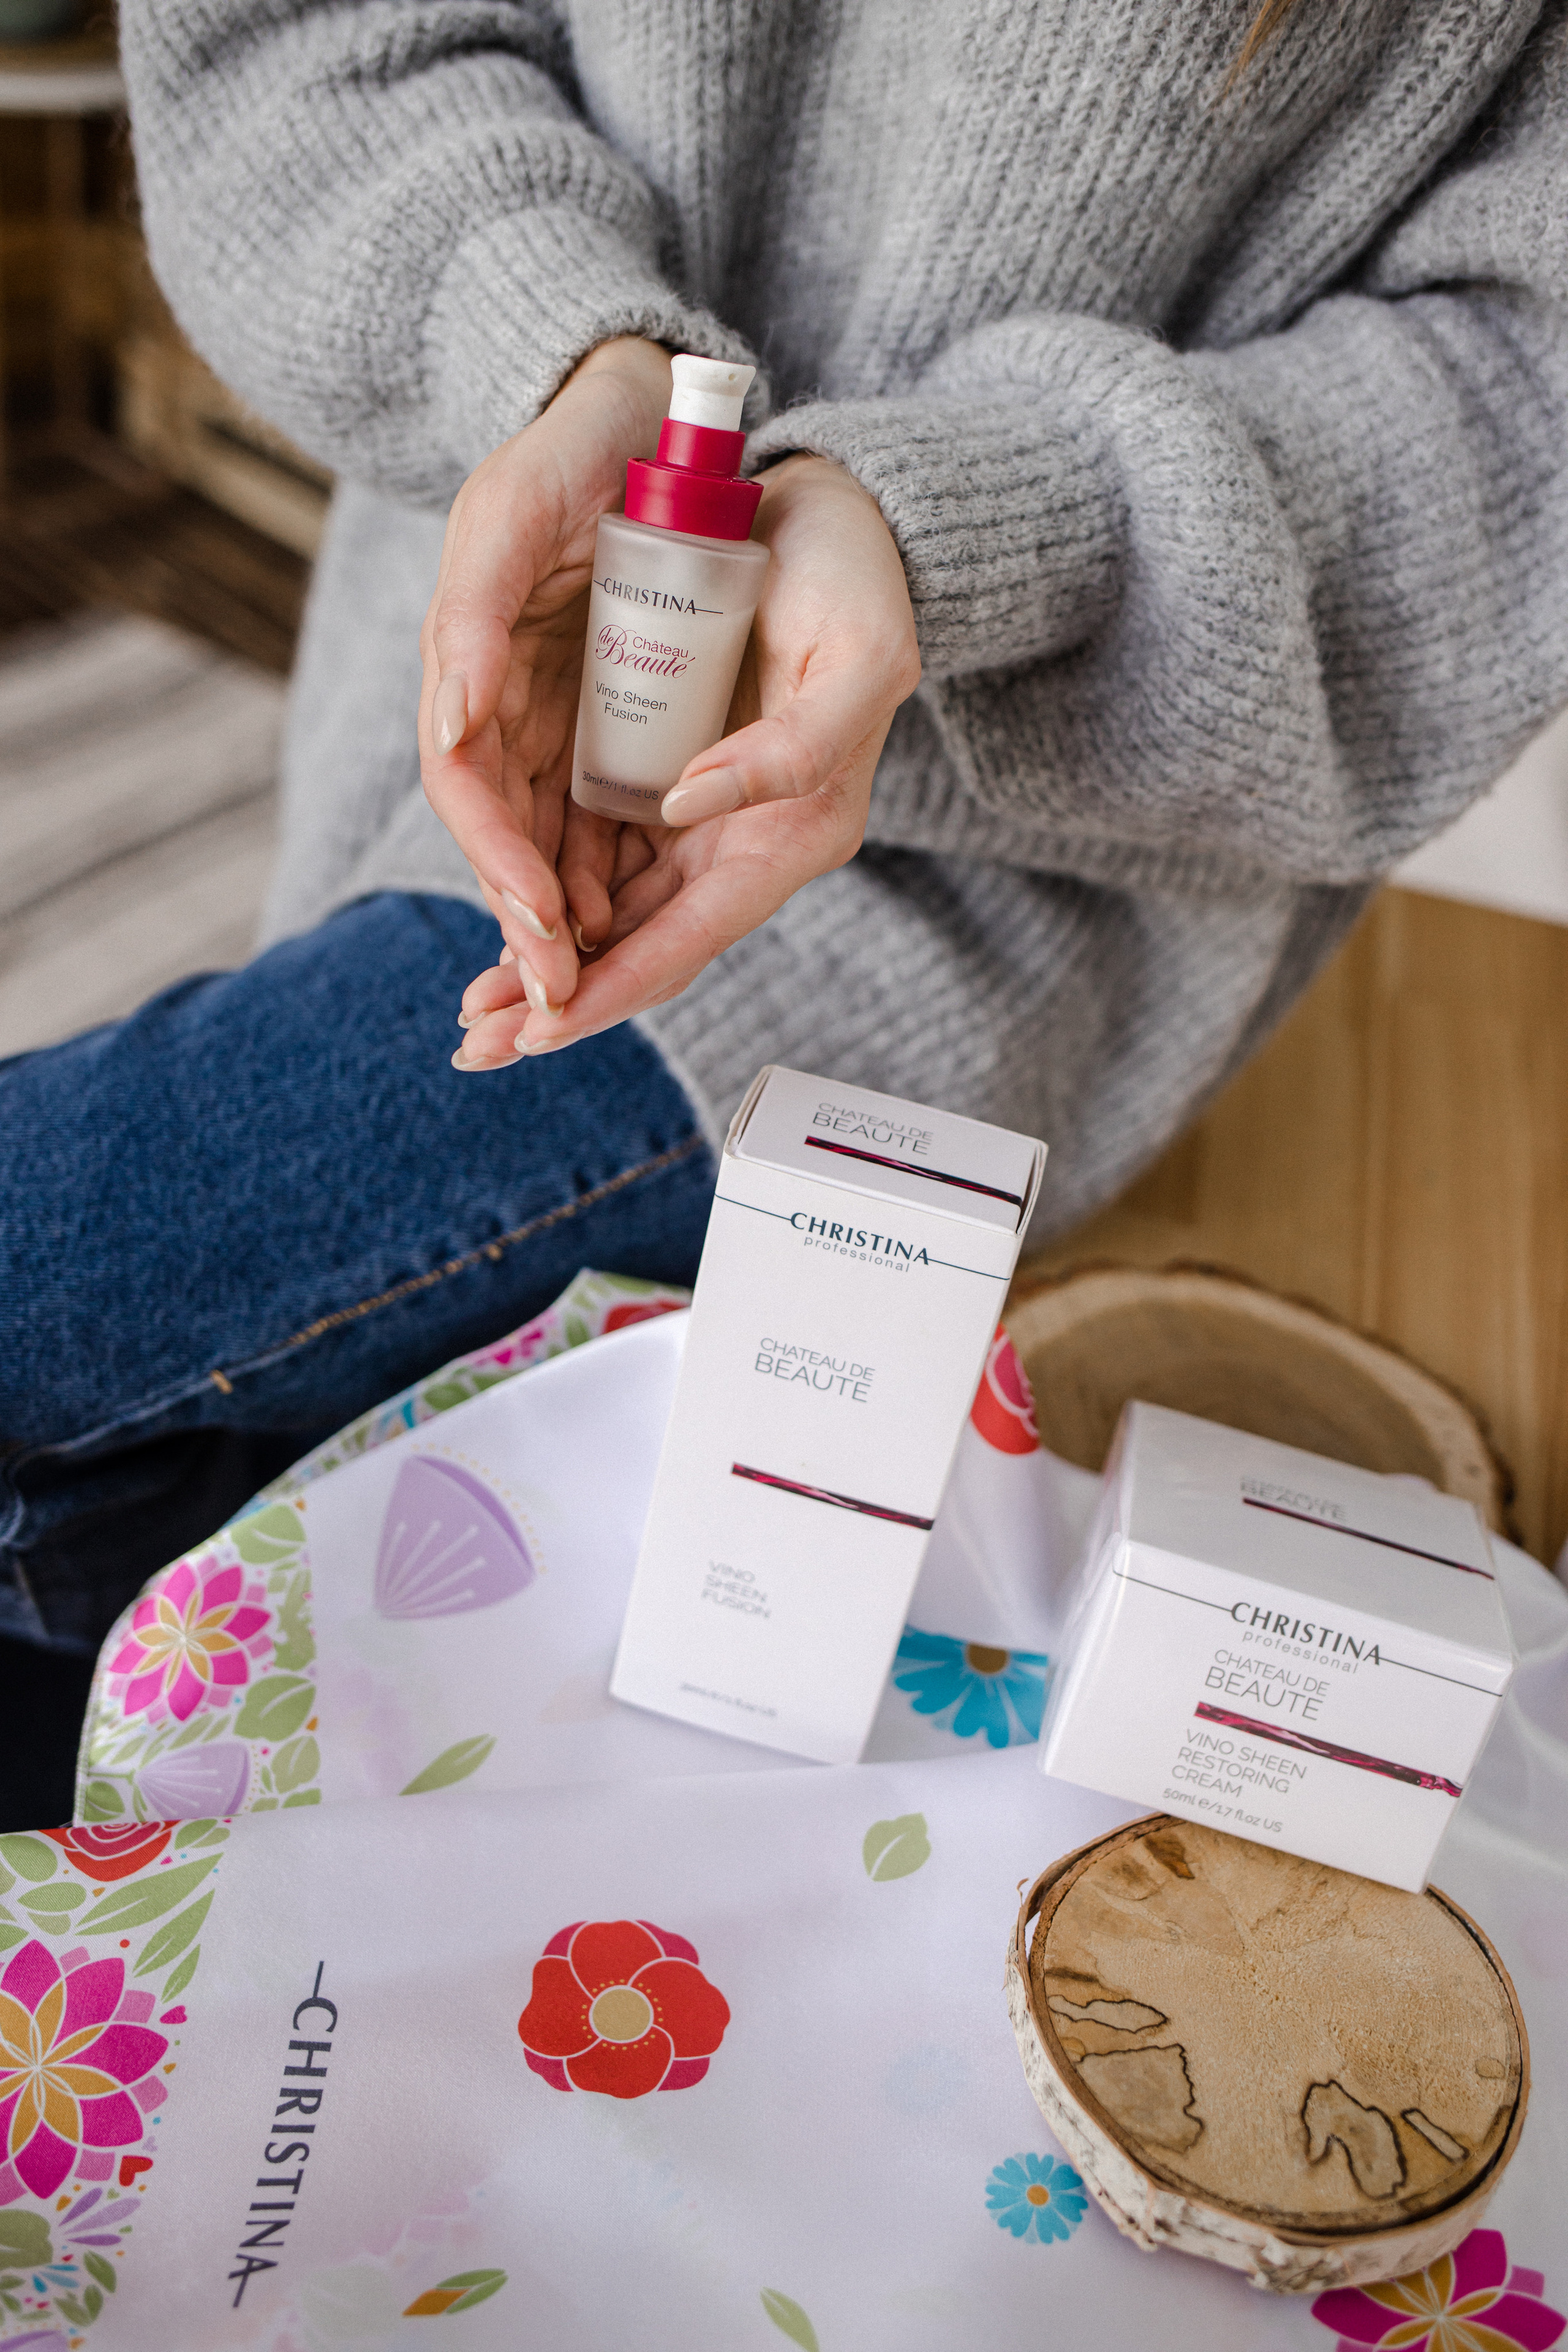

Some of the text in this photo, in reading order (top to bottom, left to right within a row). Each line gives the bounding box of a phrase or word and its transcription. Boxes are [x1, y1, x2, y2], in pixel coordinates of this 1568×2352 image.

[603, 578, 696, 615] CHRISTINA
[595, 624, 696, 679] de Beauté
[633, 636, 689, 658] Château
[596, 680, 668, 712] Vino Sheen
[604, 702, 648, 725] Fusion
[644, 789, 659, 800] US
[813, 1111, 931, 1155] BEAUTE
[818, 1102, 934, 1141] CHATEAU DE
[790, 1212, 929, 1265] CHRISTINA
[804, 1236, 910, 1273] professional
[755, 1352, 871, 1403] BEAUTE
[760, 1338, 876, 1381] CHATEAU DE
[705, 1573, 768, 1604] SHEEN
[709, 1559, 756, 1584] VINO
[701, 1588, 772, 1619] FUSION
[1231, 1602, 1381, 1666] CHRISTINA
[1242, 1630, 1359, 1674] professional
[1205, 1666, 1324, 1721] BEAUTE
[1214, 1649, 1330, 1697] CHATEAU DE
[1177, 1746, 1291, 1794] RESTORING
[1186, 1728, 1308, 1779] VINO SHEEN
[1171, 1765, 1243, 1798] CREAM
[1163, 1787, 1195, 1806] 50ml
[1263, 1818, 1284, 1833] US
[228, 1996, 338, 2280] CHRISTINA
